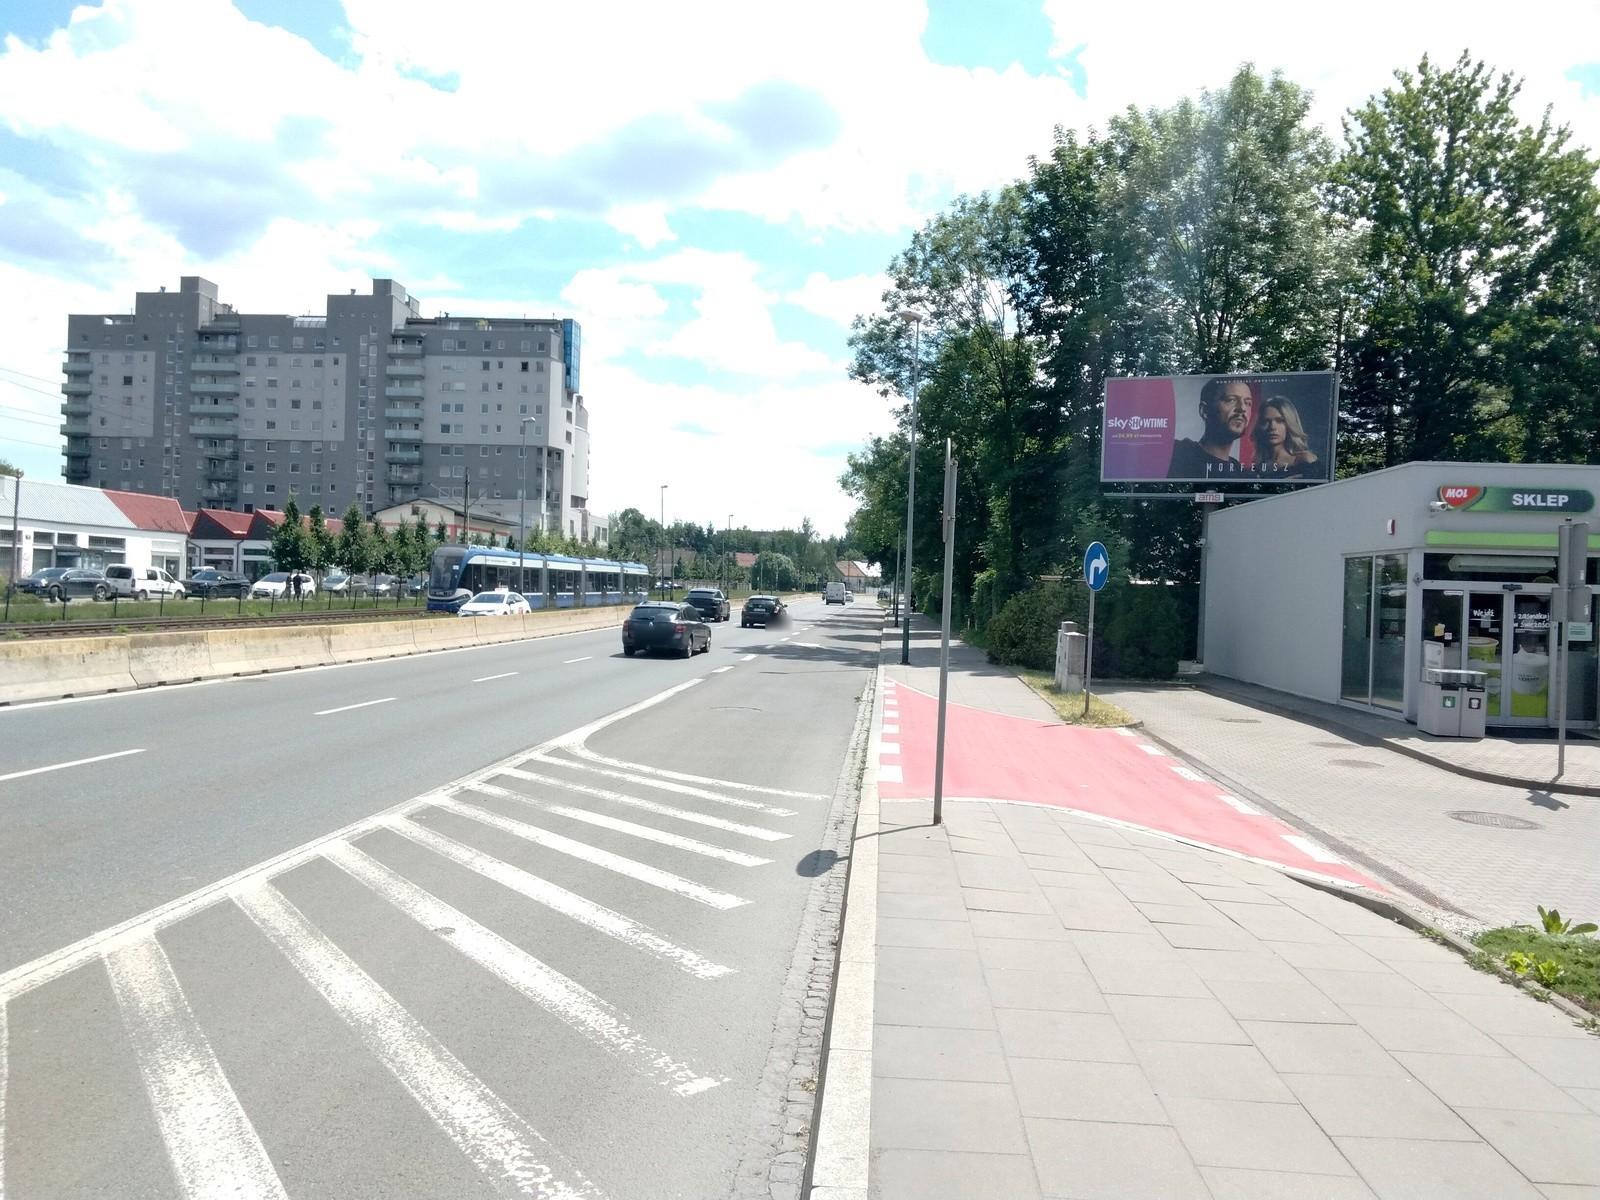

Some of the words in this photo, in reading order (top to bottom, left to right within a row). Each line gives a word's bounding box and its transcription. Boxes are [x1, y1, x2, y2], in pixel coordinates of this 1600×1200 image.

[1205, 462, 1289, 475] MORFEUSZ
[1445, 488, 1469, 499] MOL
[1511, 493, 1570, 507] SKLEP
